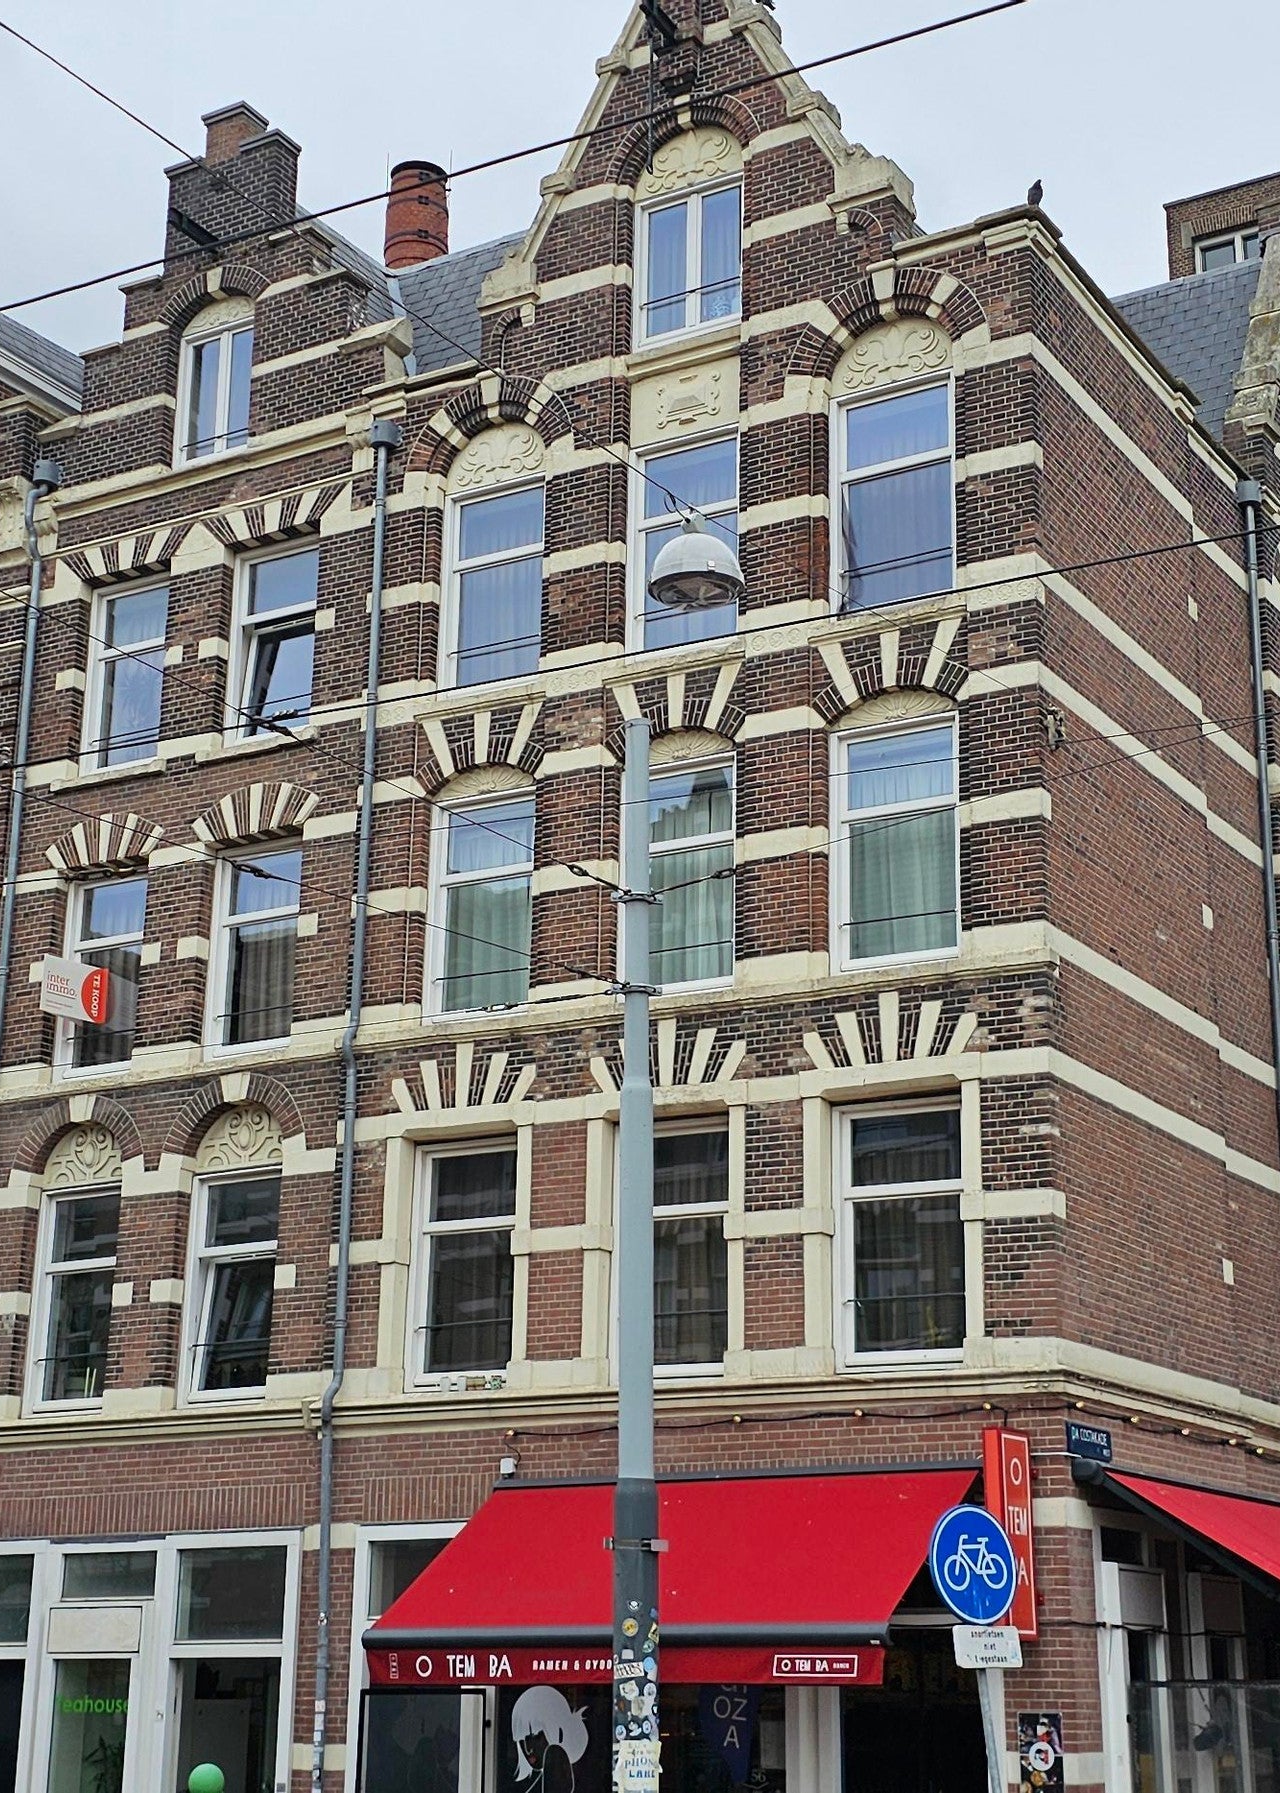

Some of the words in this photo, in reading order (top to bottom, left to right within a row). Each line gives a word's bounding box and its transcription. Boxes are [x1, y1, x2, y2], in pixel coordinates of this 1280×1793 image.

[47, 970, 70, 986] inter
[92, 974, 101, 988] TE
[91, 989, 100, 1017] KOOP
[1010, 1457, 1023, 1486] O
[1008, 1505, 1028, 1536] TEM
[415, 1655, 433, 1678] O
[446, 1655, 476, 1678] TEM
[489, 1654, 513, 1678] BA
[781, 1659, 791, 1672] O
[795, 1659, 811, 1672] TEM
[713, 1696, 748, 1721] OZ
[723, 1725, 740, 1749] A
